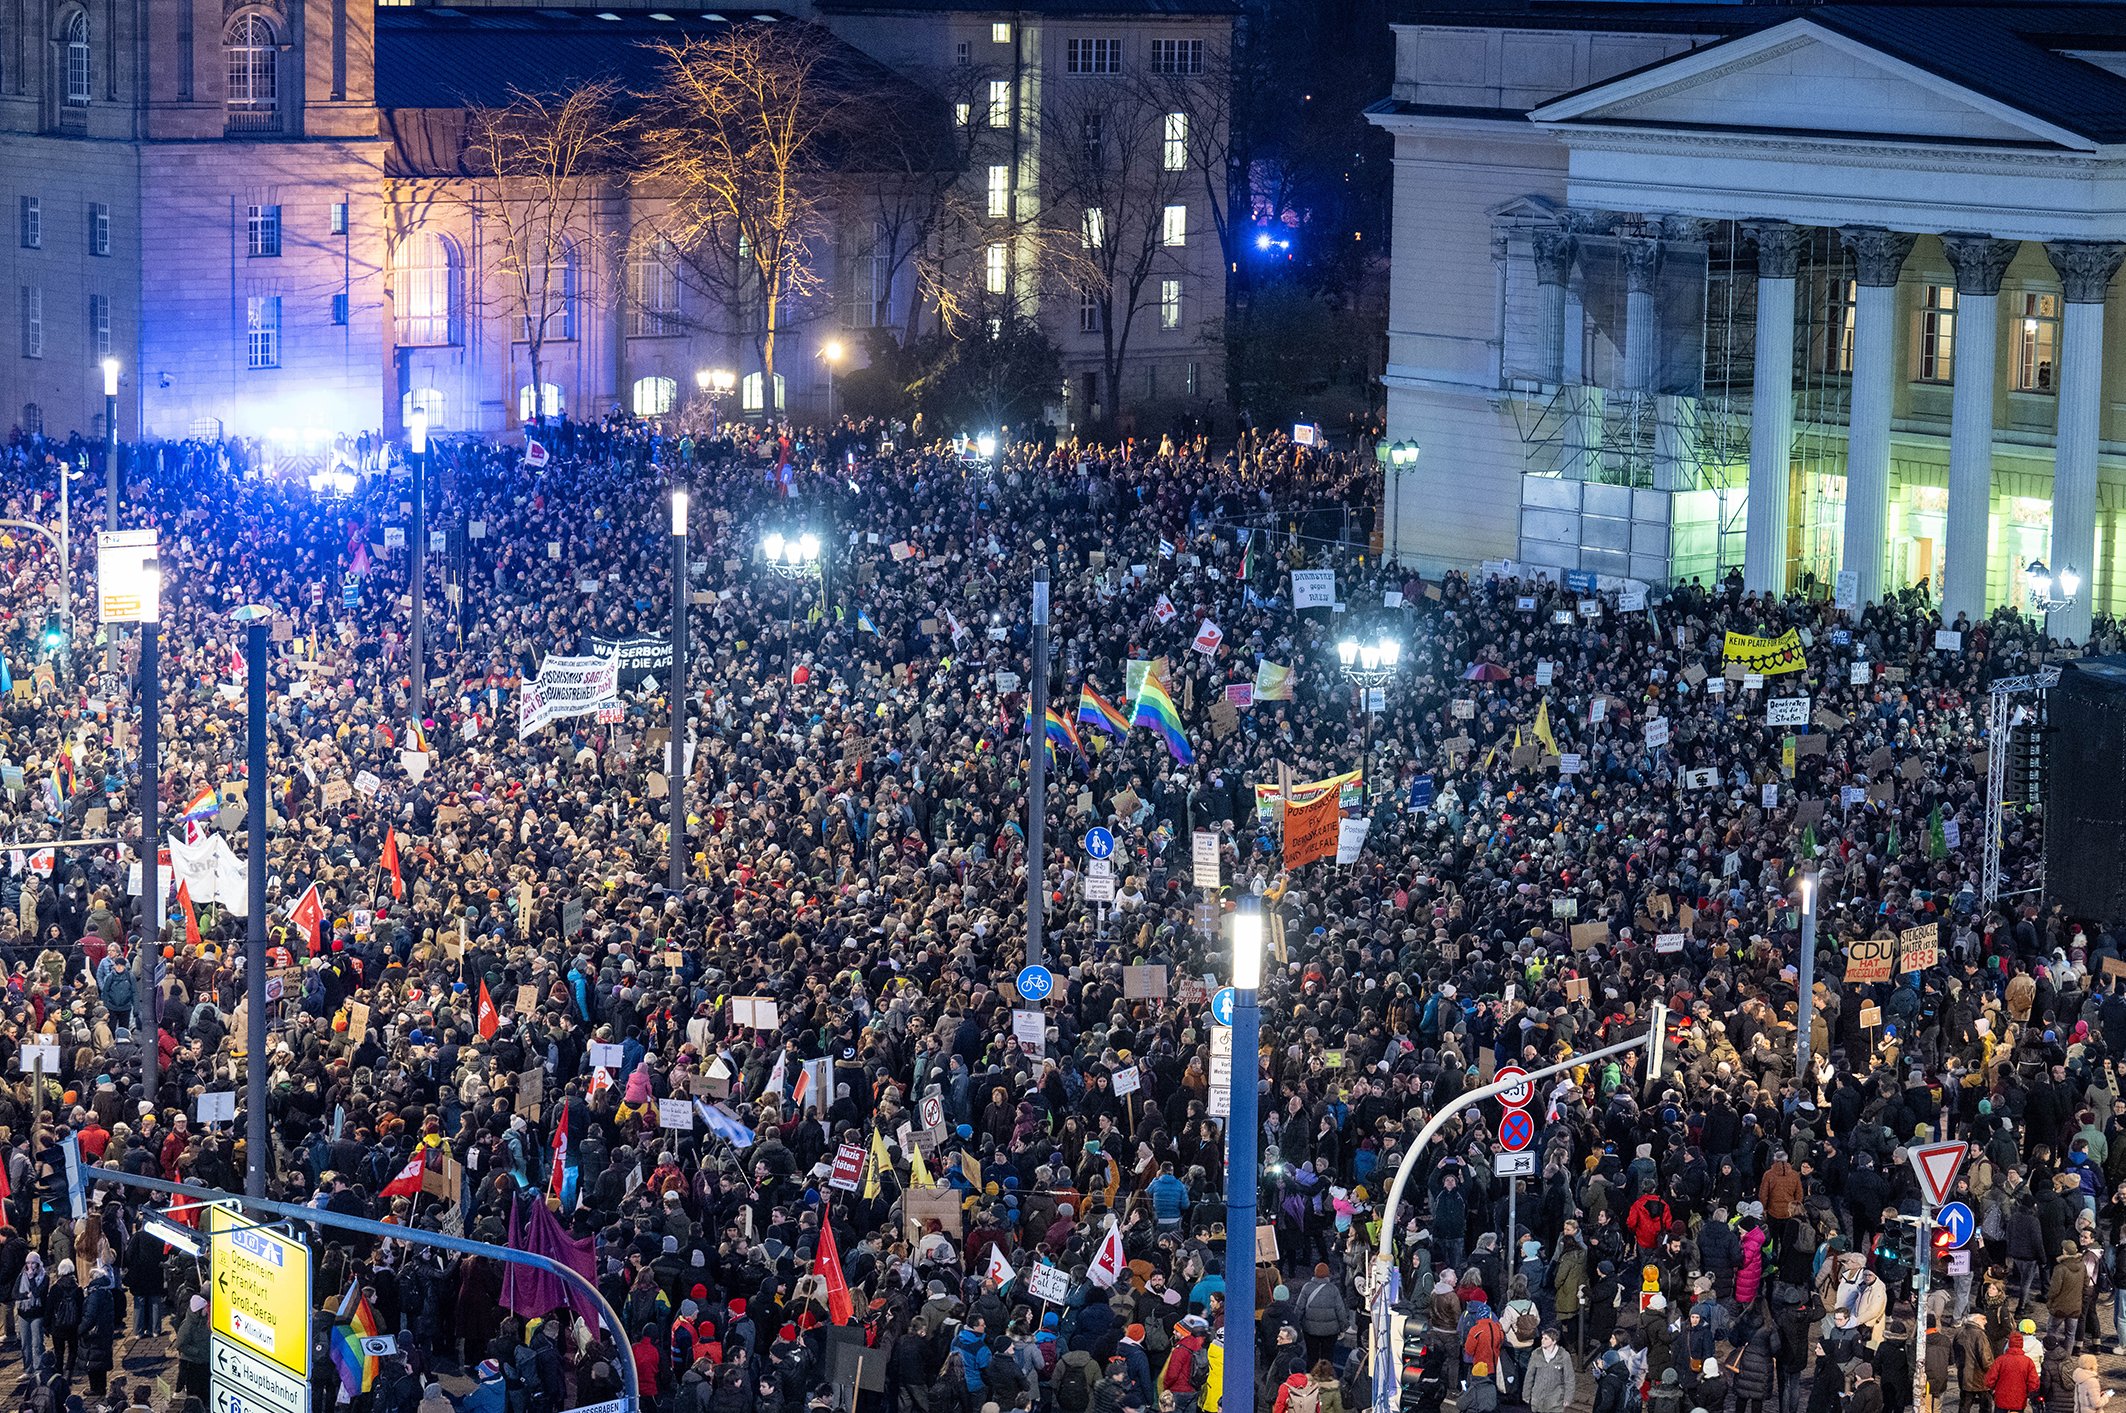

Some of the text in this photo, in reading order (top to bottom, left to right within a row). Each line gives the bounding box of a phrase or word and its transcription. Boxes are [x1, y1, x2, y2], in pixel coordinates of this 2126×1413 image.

[1729, 637, 1746, 646] KEIN
[1748, 639, 1766, 648] PLATZ
[632, 658, 651, 668] DIE
[1850, 942, 1893, 961] CDU
[1903, 949, 1934, 970] 1933
[1859, 958, 1880, 968] HAT
[839, 1147, 860, 1161] Nazis
[836, 1160, 857, 1173] töten.
[231, 1249, 274, 1283] Oppenheim
[1034, 1264, 1051, 1280] Auf
[231, 1269, 267, 1301] Frankfurt
[1032, 1275, 1049, 1288] Fall
[231, 1290, 276, 1326] Groß-Gerau
[245, 1321, 273, 1346] Klinikum
[243, 1364, 298, 1405] Hauptbahnhof
